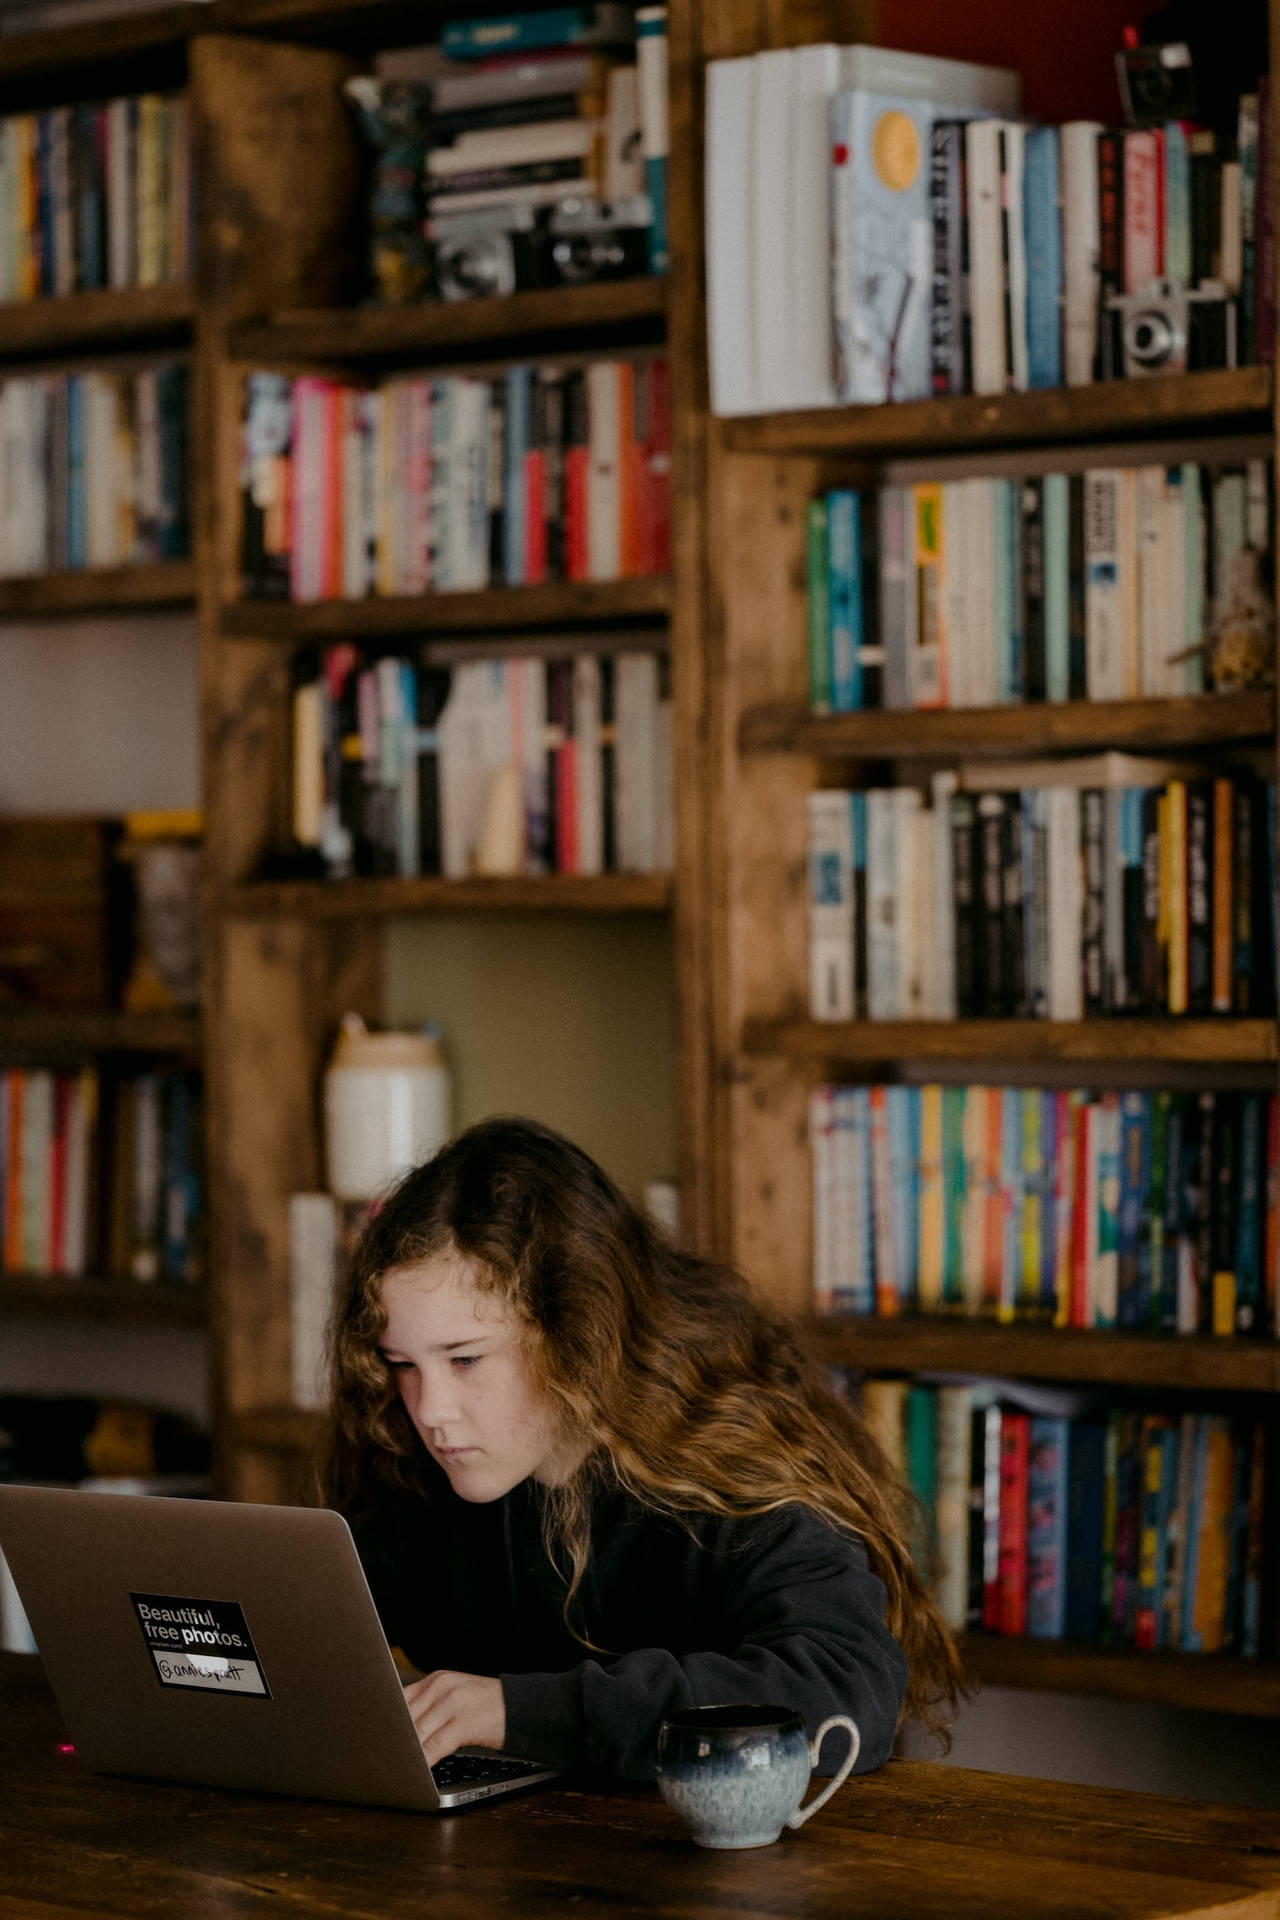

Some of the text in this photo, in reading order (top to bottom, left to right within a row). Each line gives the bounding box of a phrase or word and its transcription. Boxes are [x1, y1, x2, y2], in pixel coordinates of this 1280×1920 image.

[138, 1603, 220, 1629] Beautiful,
[144, 1621, 247, 1647] free photos.
